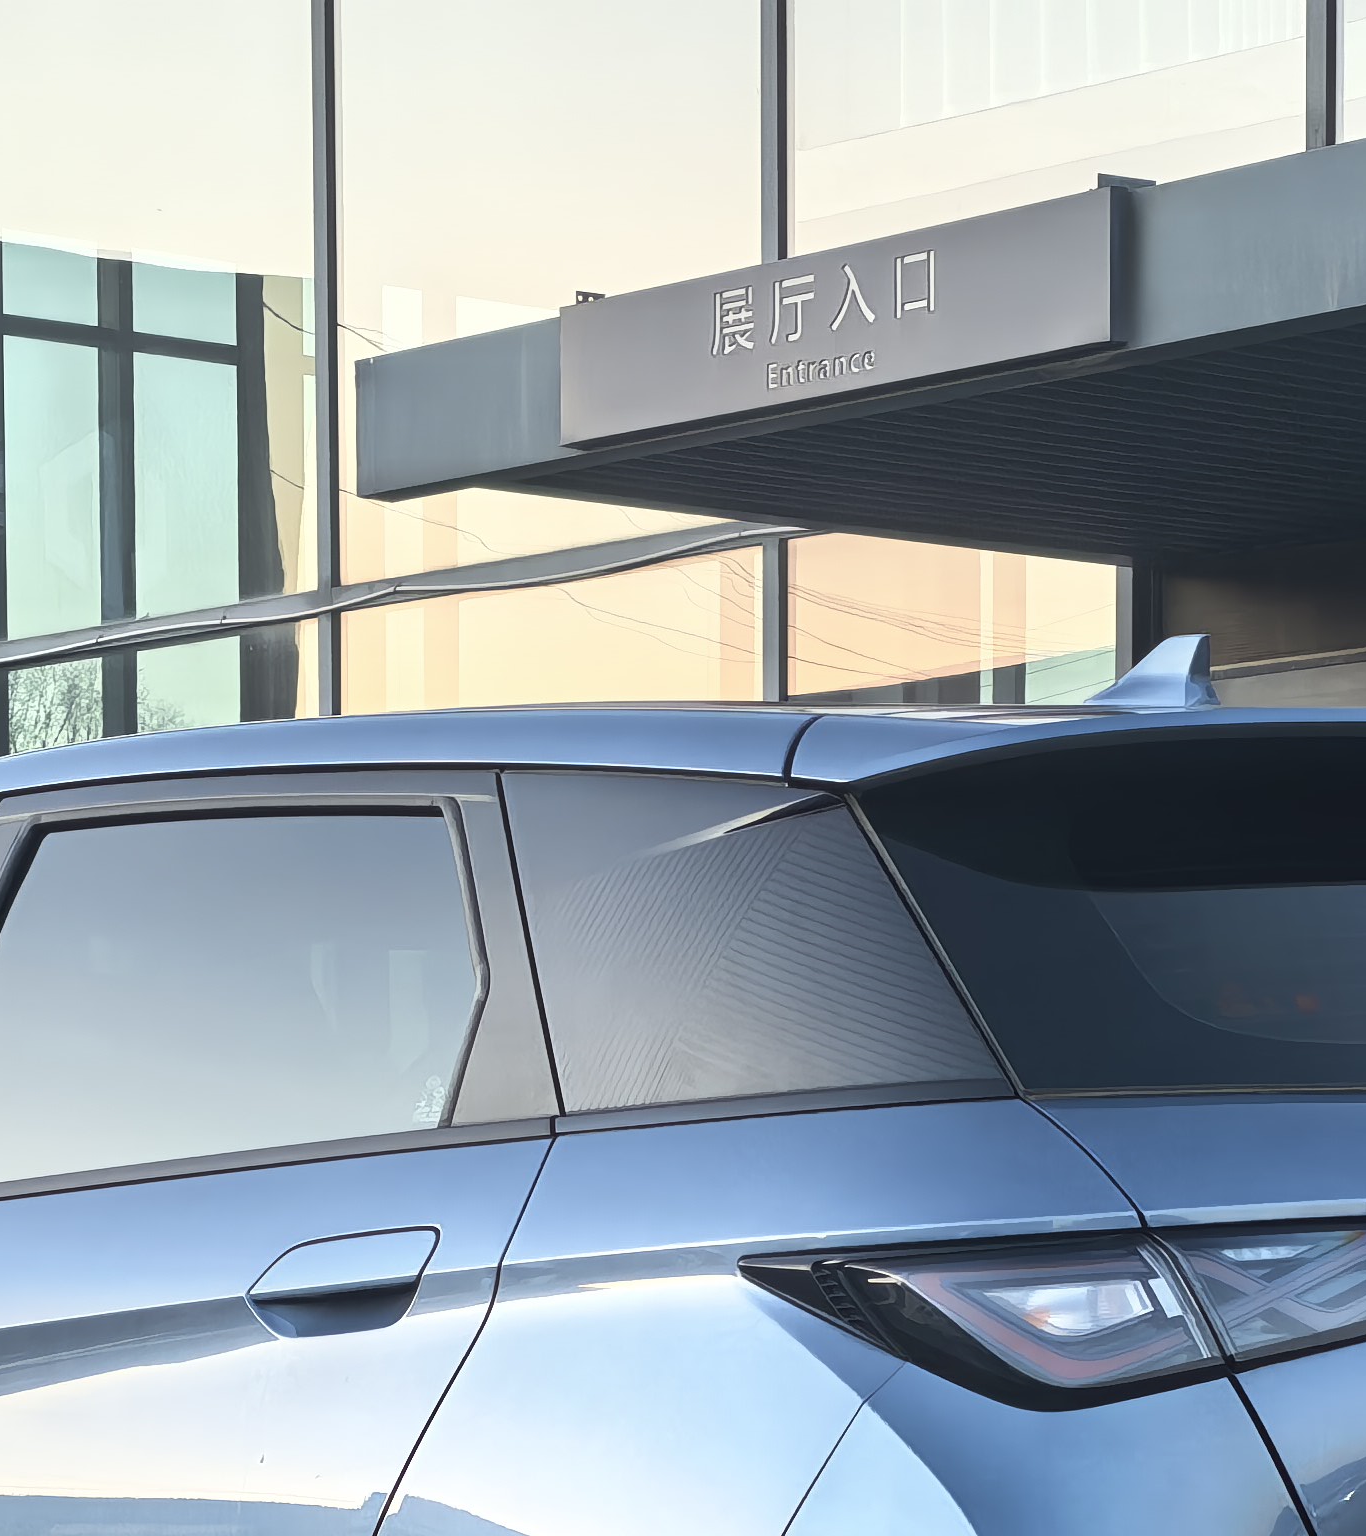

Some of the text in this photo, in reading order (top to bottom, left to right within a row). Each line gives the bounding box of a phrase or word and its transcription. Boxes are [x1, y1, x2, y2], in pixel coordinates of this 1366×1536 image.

[712, 249, 935, 357] 展厅入口
[767, 350, 876, 390] Entrance
